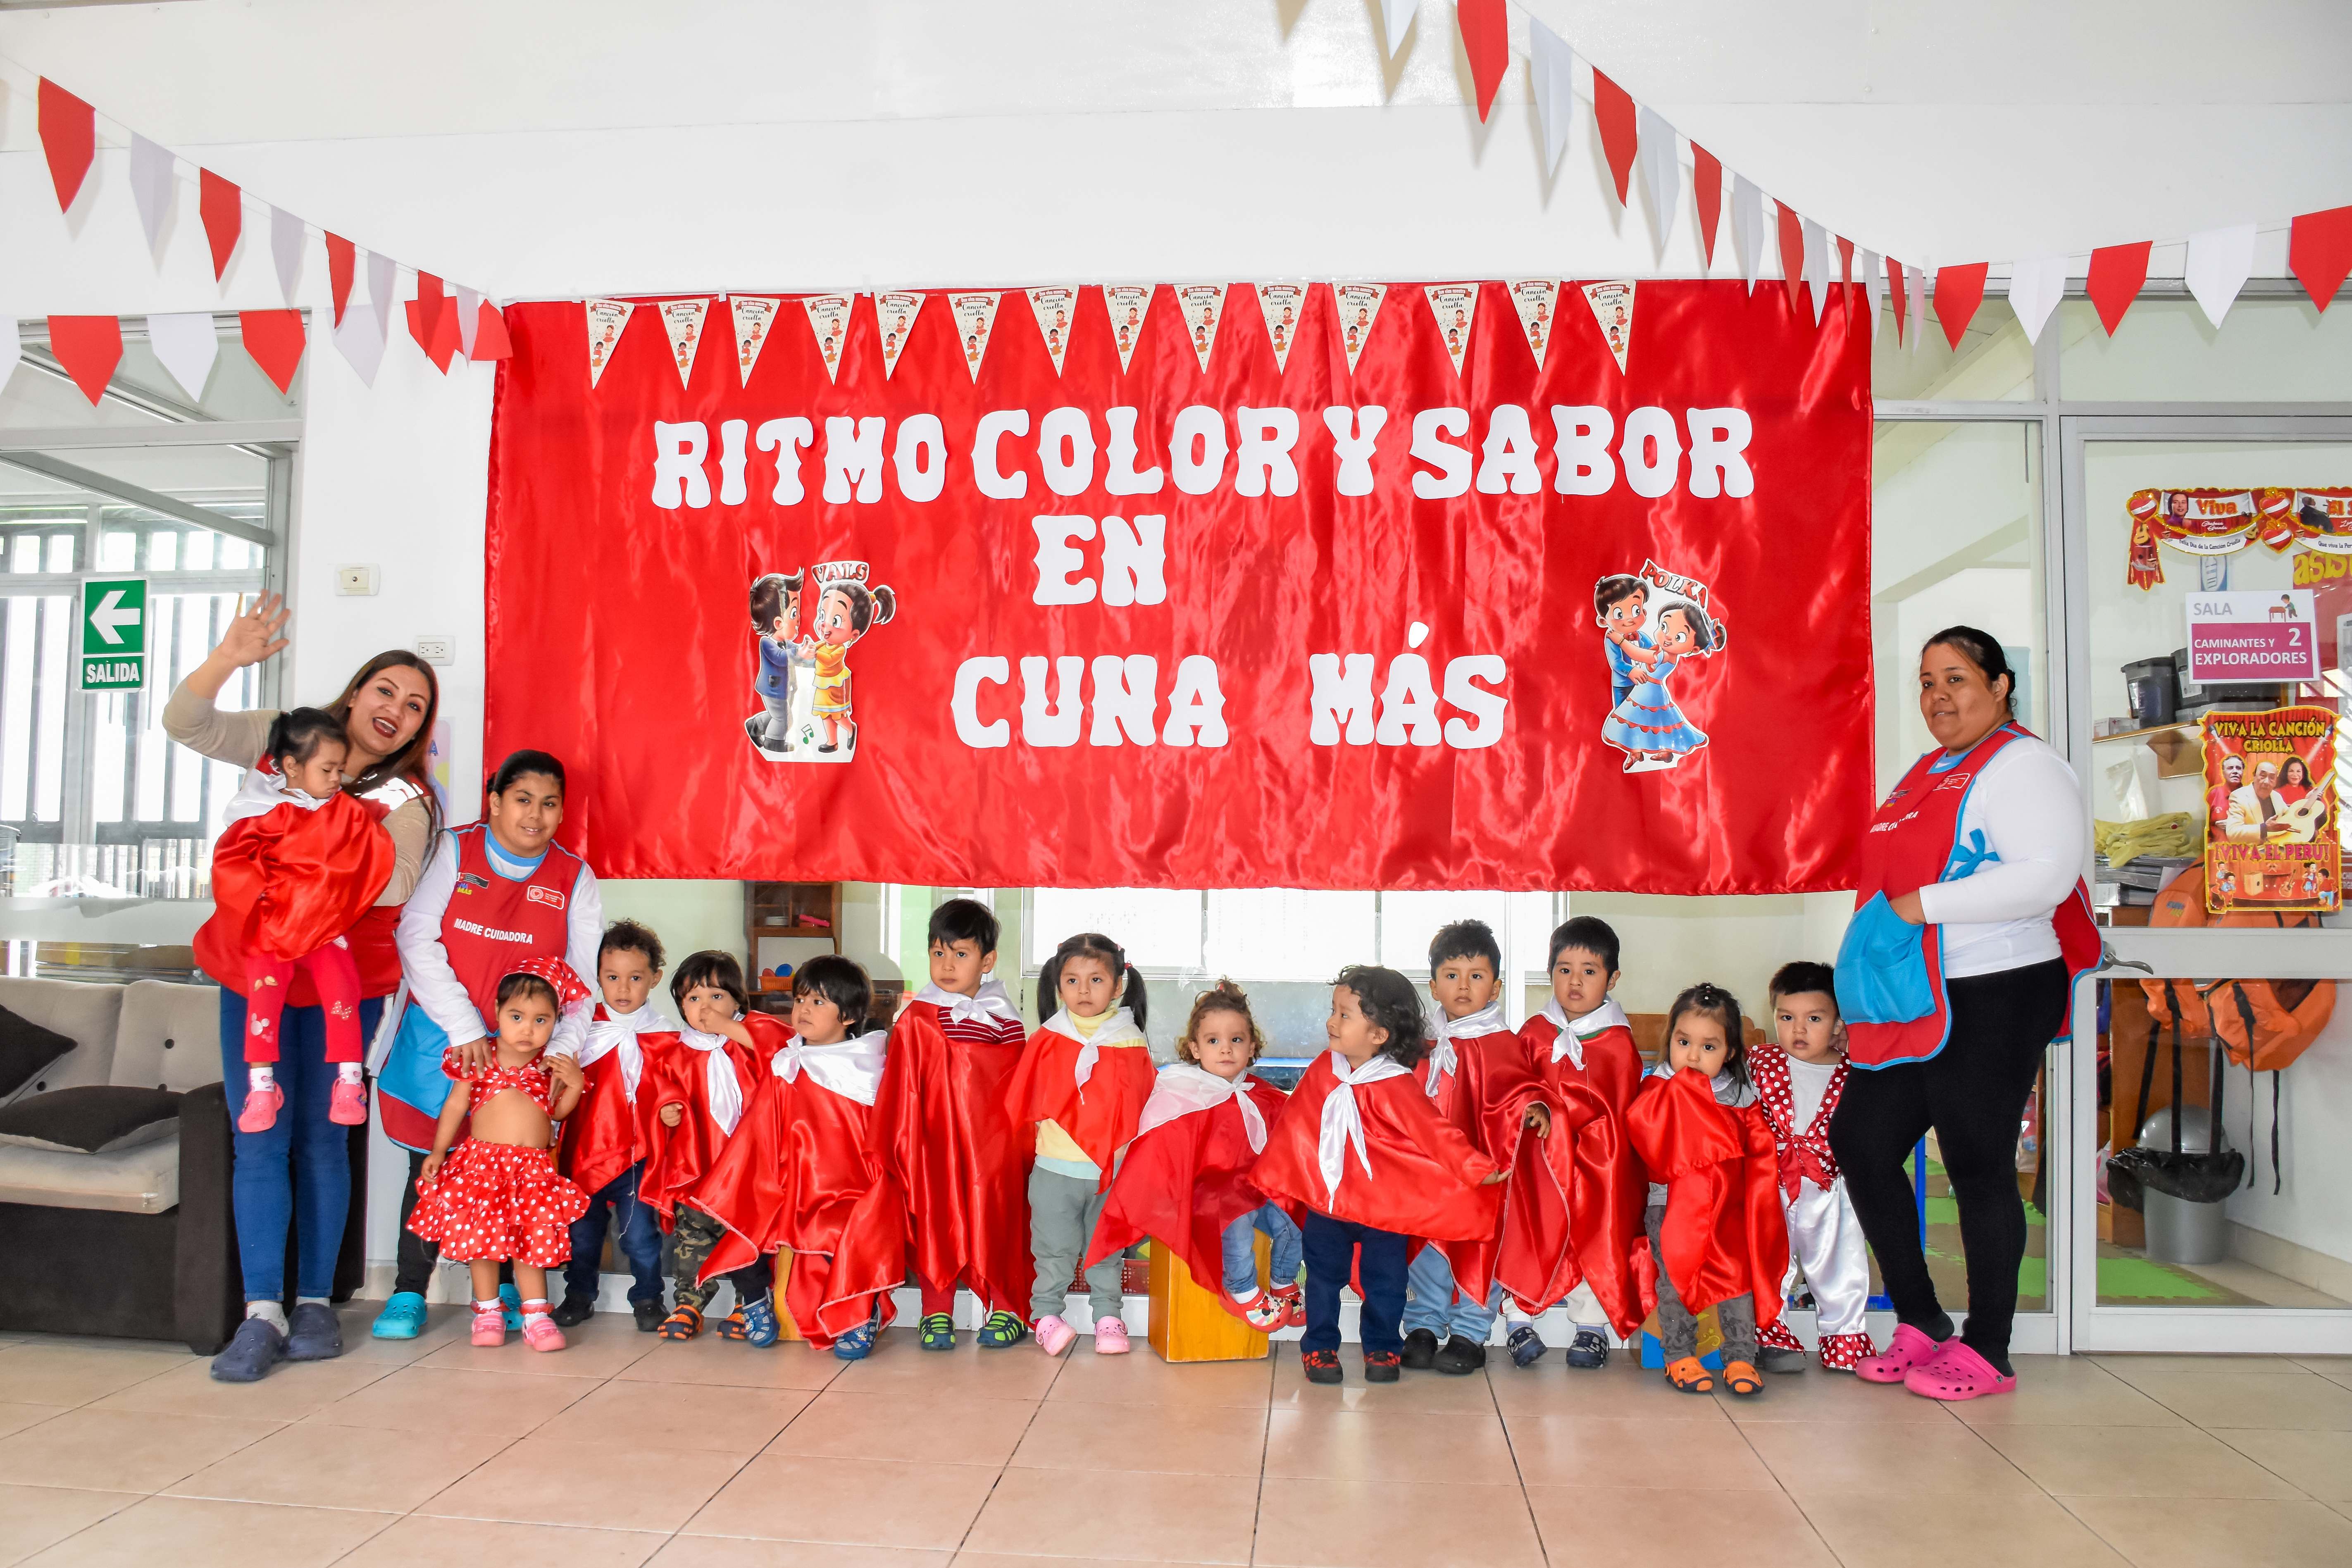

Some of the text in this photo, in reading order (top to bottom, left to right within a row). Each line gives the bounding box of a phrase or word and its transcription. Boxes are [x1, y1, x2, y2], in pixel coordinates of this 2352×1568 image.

[1601, 298, 1623, 307] criolla
[652, 404, 1754, 509] RITMO COLOR Y SABOR
[2195, 499, 2238, 515] Viva
[1032, 514, 1167, 607] EN
[813, 563, 867, 583] VALS
[1641, 560, 1707, 608] POLKA
[2193, 603, 2232, 616] SALA
[2194, 628, 2302, 648] CAMINANTES Y 2
[2195, 652, 2307, 665] EXPLORADORES
[86, 662, 140, 683] SALIDA
[951, 621, 1508, 749] CUNA MÁS
[2214, 717, 2326, 737] VIVA LA CANCIÓN
[2243, 739, 2294, 753] CRIOLLA
[2215, 837, 2329, 861] ¡VIVA EL PERÚ!
[454, 918, 533, 944] MADRE CUIDADORA
